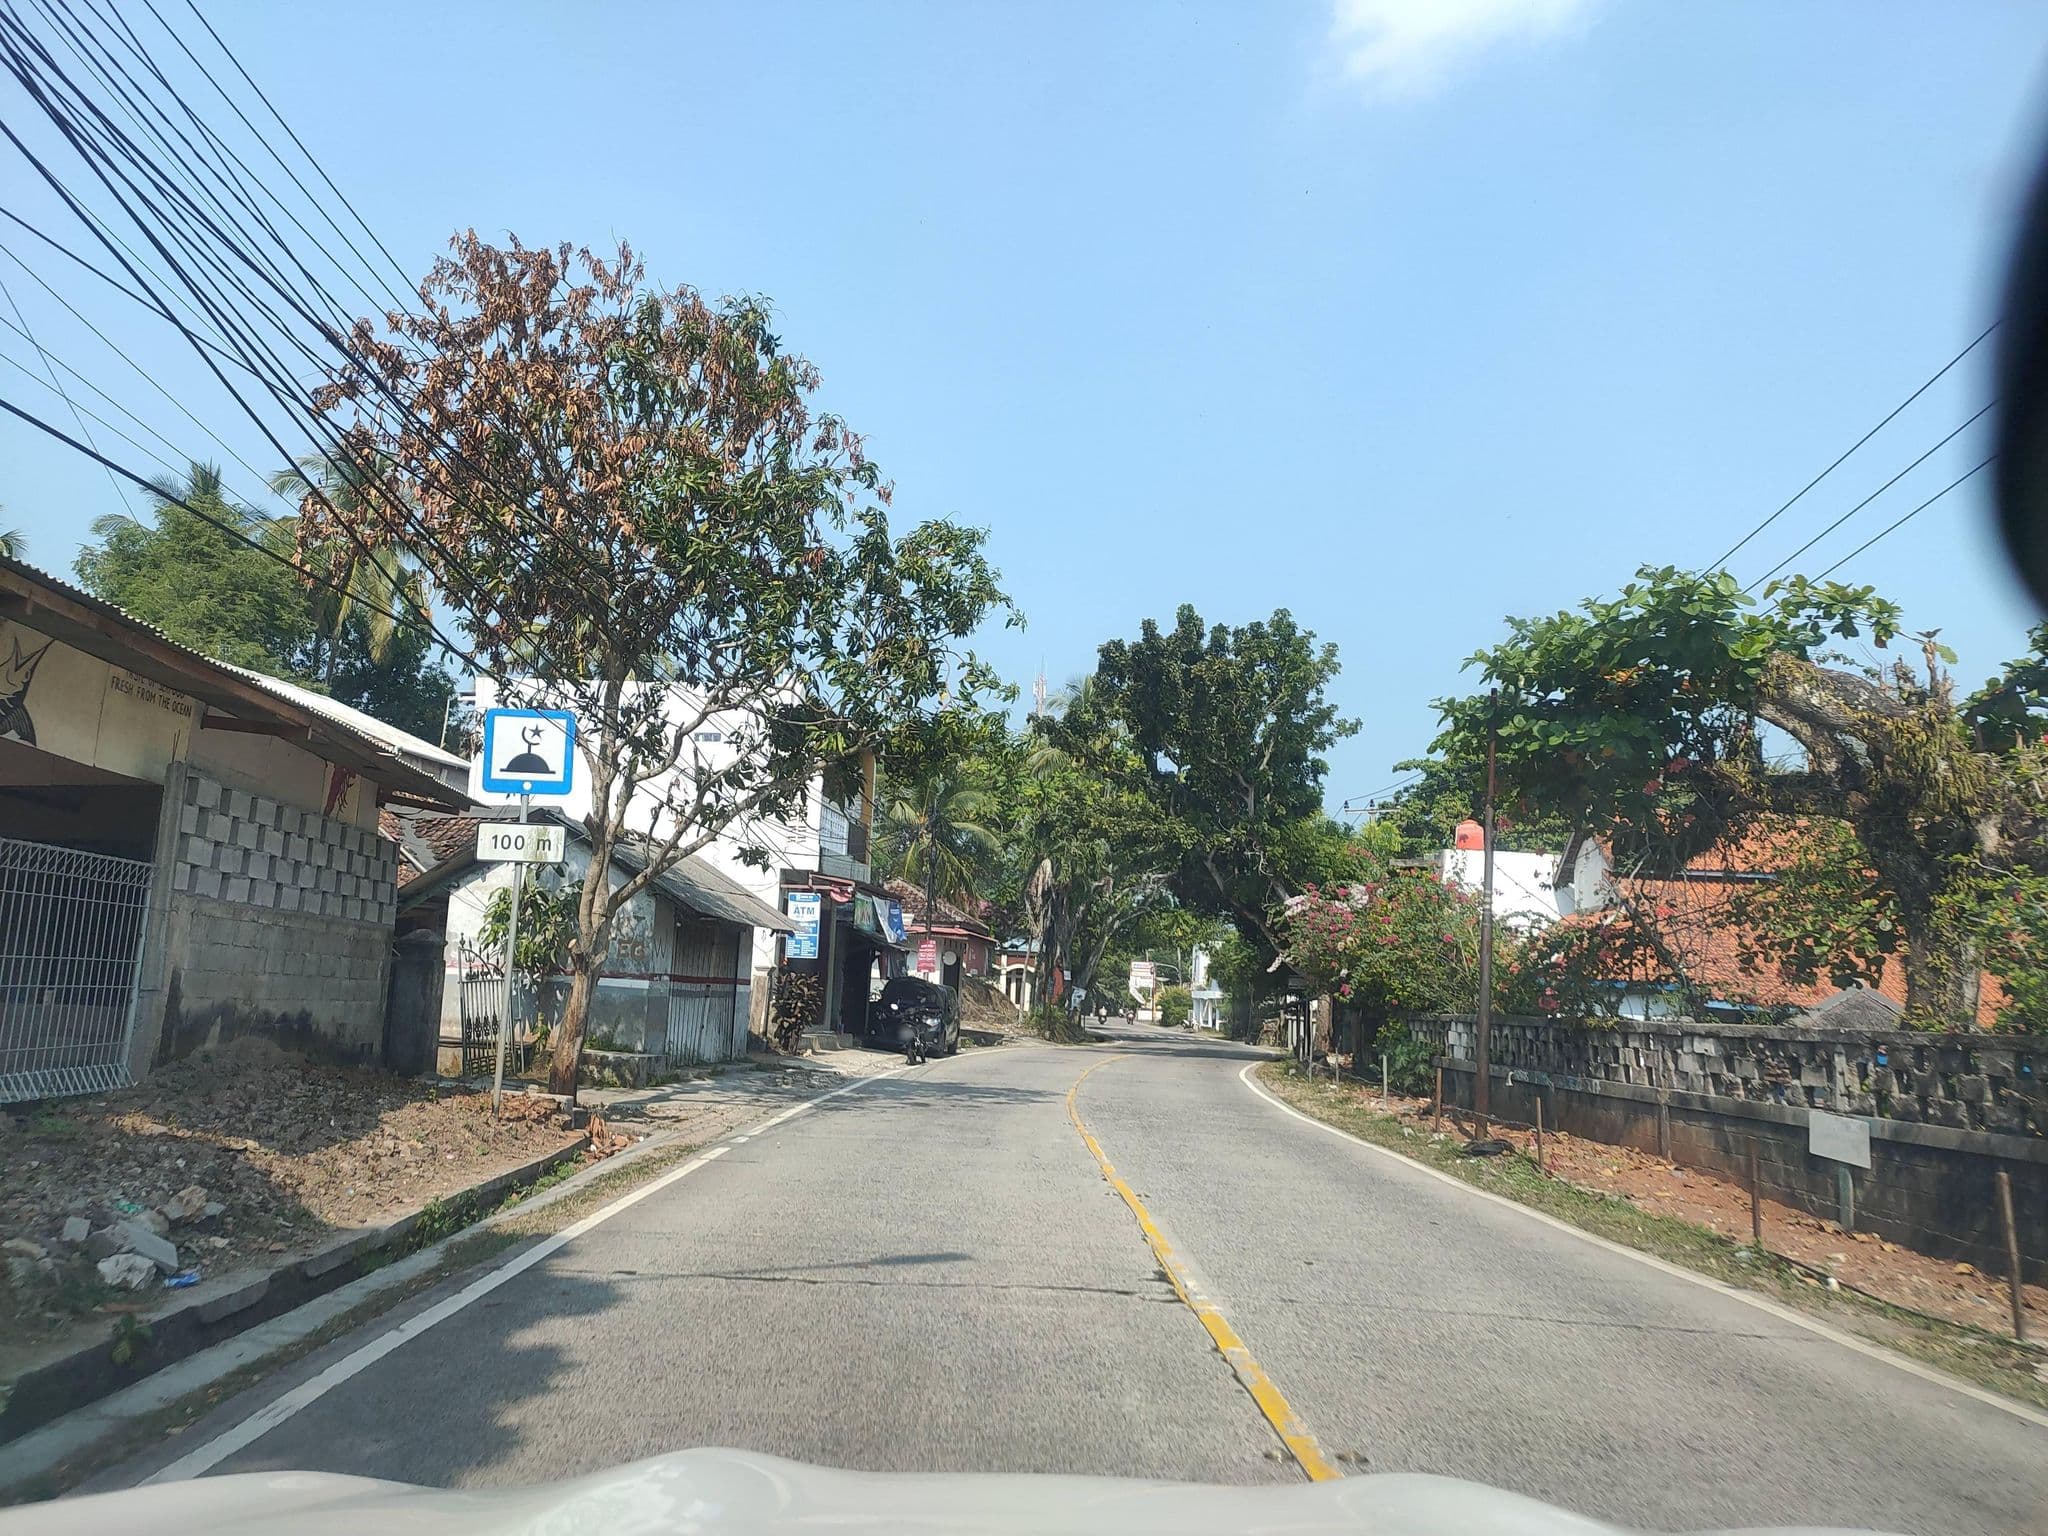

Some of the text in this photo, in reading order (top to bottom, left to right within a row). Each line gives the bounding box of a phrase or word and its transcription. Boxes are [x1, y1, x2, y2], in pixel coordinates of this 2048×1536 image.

[111, 675, 134, 695] FRESH
[136, 686, 156, 704] FROM
[157, 694, 171, 710] THE
[172, 700, 193, 718] OCEAN
[492, 834, 552, 851] 100 m
[793, 906, 815, 916] ATM
